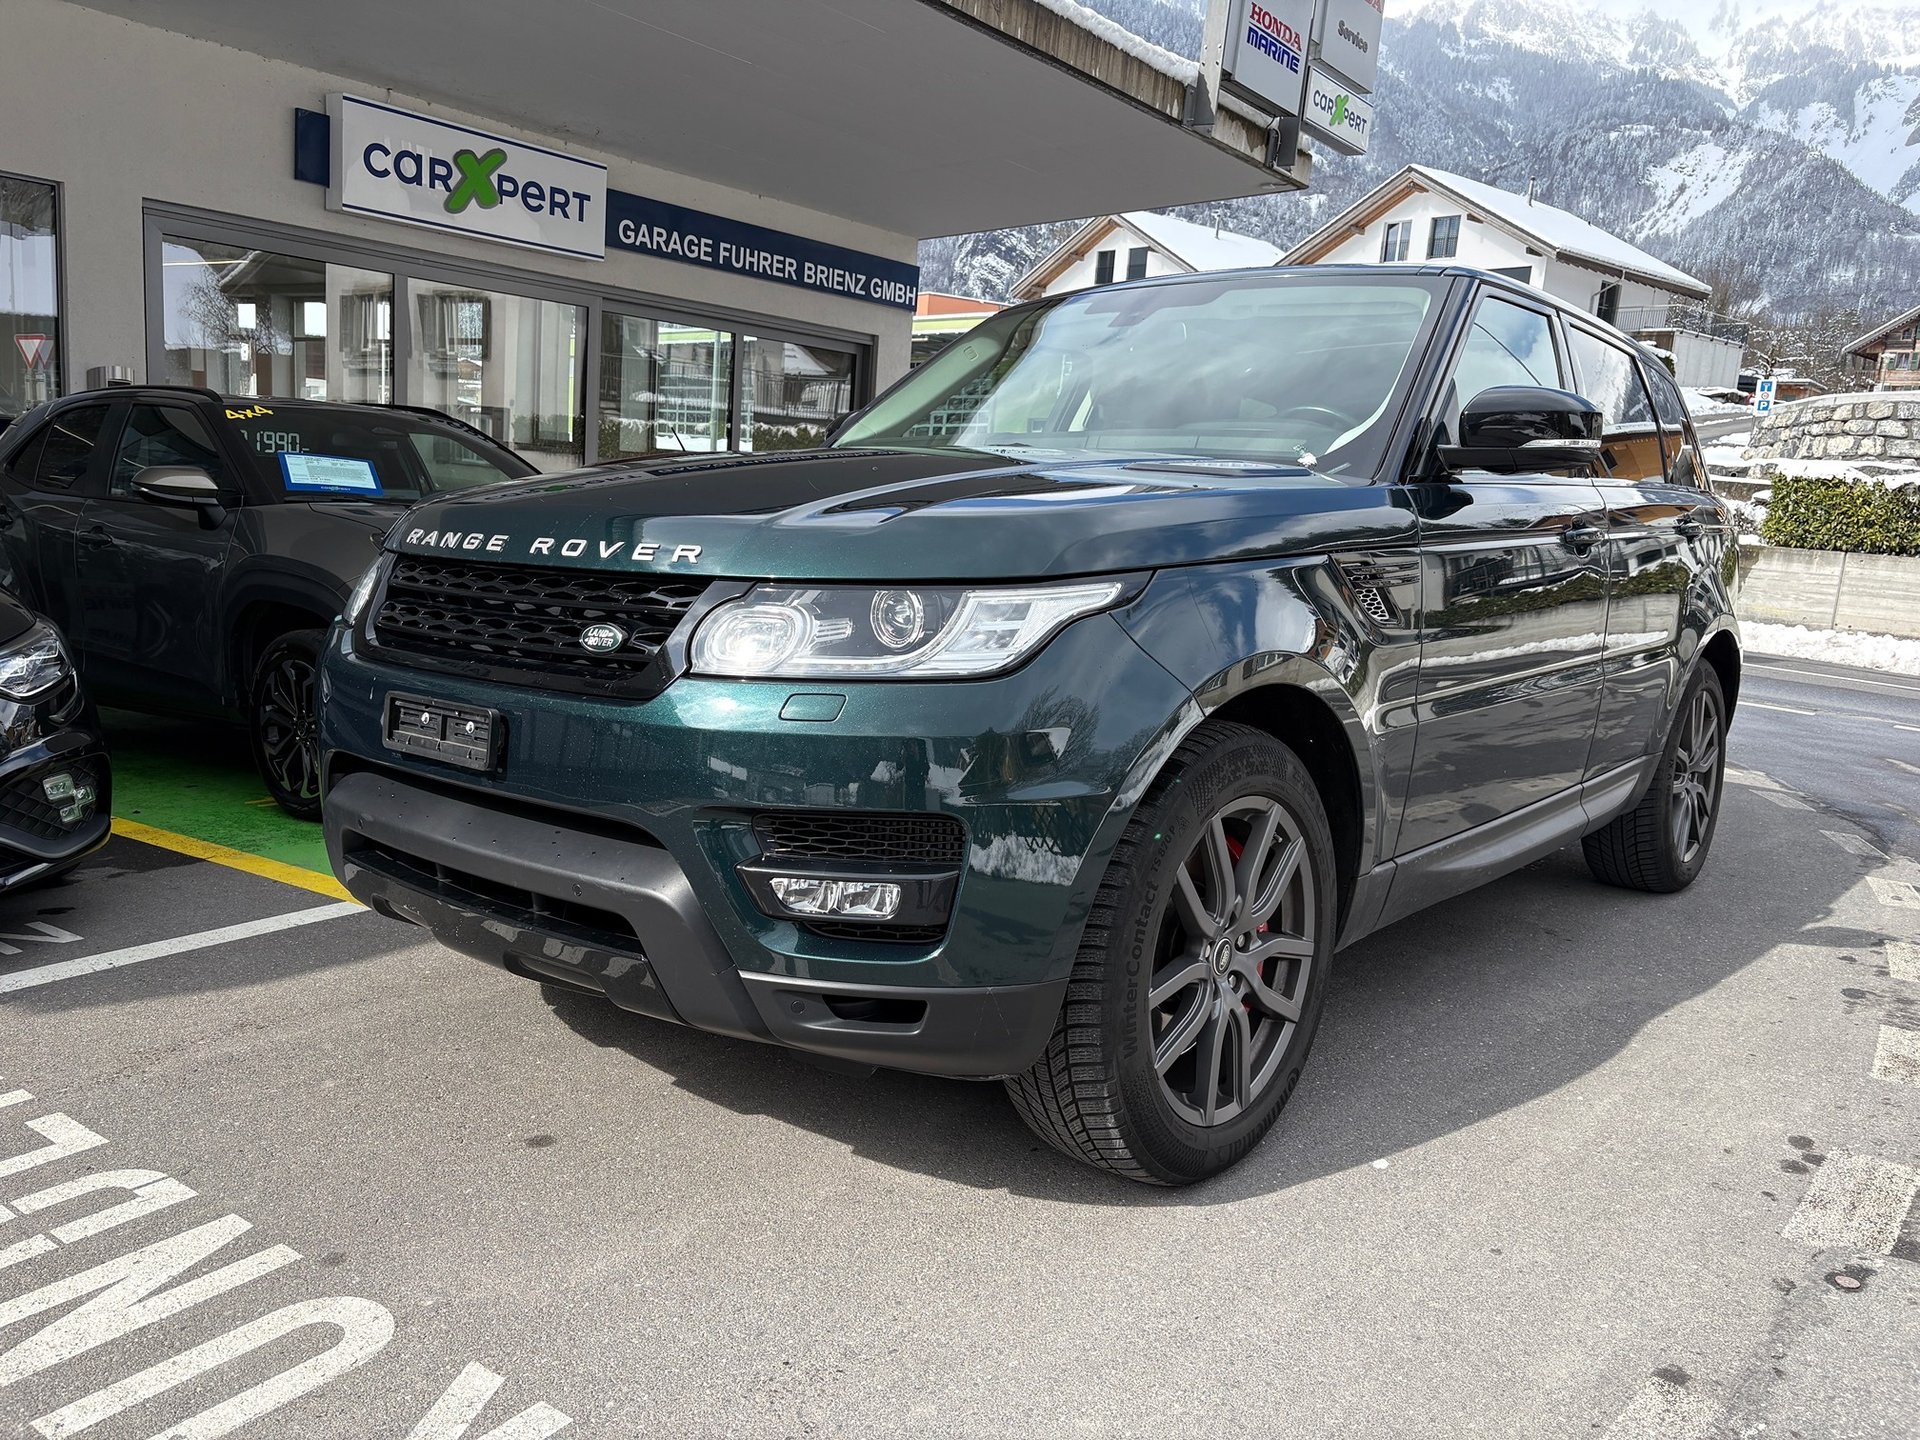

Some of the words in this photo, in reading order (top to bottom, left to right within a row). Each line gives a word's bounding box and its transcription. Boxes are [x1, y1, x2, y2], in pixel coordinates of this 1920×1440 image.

[1249, 2, 1302, 52] HONDA
[1338, 20, 1368, 53] Service
[1246, 26, 1300, 74] MARINE
[618, 219, 713, 262] GARAGE
[719, 242, 797, 280] FUHRER
[804, 262, 867, 296] BRIENZ
[870, 277, 917, 306] GMBH
[406, 528, 510, 551] RANGE
[529, 537, 703, 564] ROVER
[588, 628, 610, 638] LAND
[588, 636, 614, 647] ROVER
[1123, 881, 1159, 1060] WinterContact
